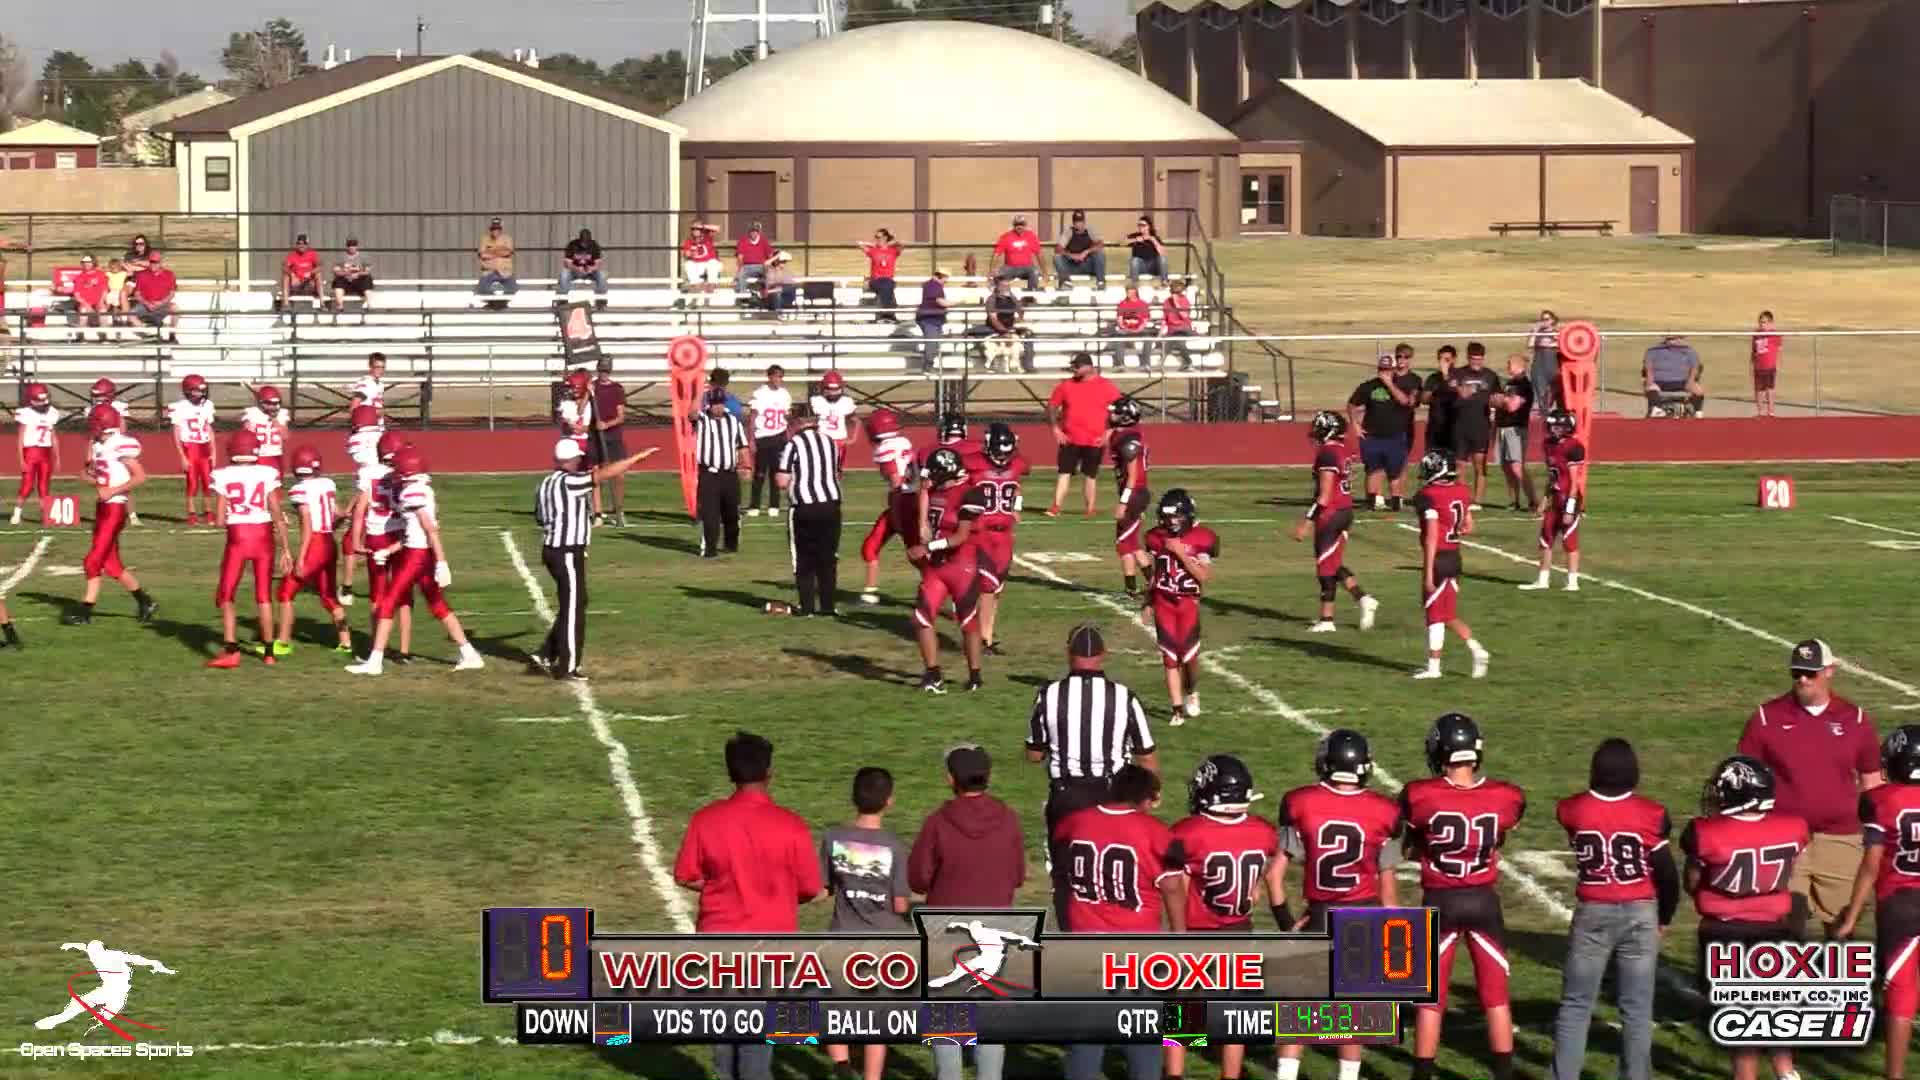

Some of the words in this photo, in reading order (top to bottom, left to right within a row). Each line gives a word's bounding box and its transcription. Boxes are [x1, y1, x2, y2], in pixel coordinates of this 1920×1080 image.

[49, 497, 74, 525] 40
[225, 481, 266, 515] 24
[1766, 479, 1790, 508] 20
[1446, 500, 1464, 543] 1
[1316, 820, 1365, 892] 2
[1428, 811, 1499, 878] 21
[1575, 831, 1648, 885] 28
[1711, 842, 1799, 896] 47
[1068, 839, 1144, 913] 90
[1202, 850, 1266, 916] 20
